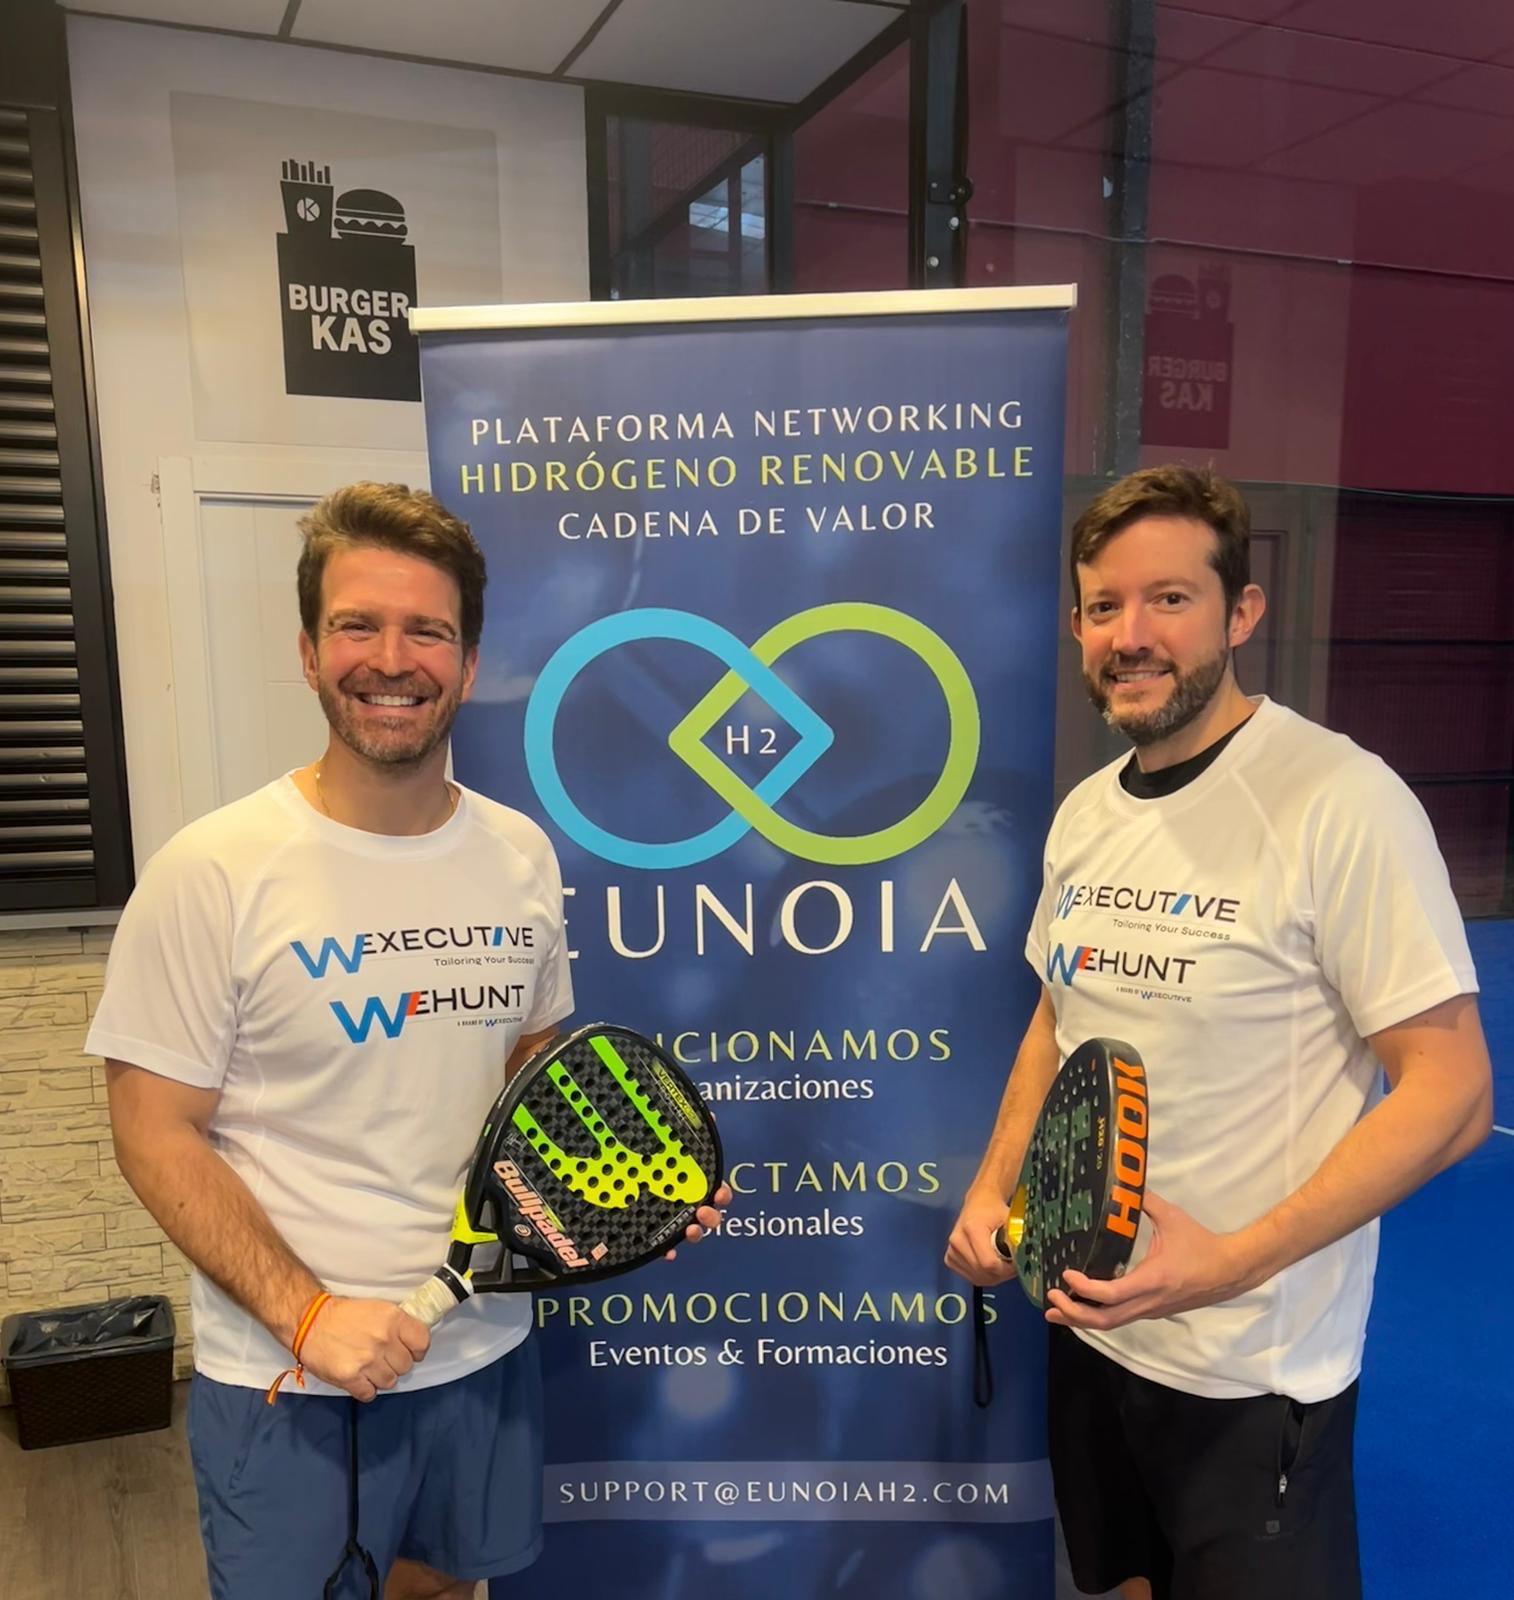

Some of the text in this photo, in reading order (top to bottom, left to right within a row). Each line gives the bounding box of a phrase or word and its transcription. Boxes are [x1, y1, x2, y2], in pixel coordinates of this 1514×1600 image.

[288, 283, 410, 318] BURGER
[311, 315, 392, 354] KAS
[472, 401, 1022, 446] PLATAFORMA NETWORKING
[461, 446, 1034, 494] HIDRÓGENO RENOVABLE
[558, 502, 935, 540] CADENA DE VALOR
[1113, 918, 1231, 941] Tailoring Your Success
[433, 956, 482, 967] Tailoring
[484, 956, 506, 964] Your
[1046, 940, 1197, 986] WEHUNT
[329, 984, 525, 1044] WEHUNT
[656, 1029, 952, 1063] CIONAMOS
[693, 1073, 874, 1101] anizaciones
[1106, 1057, 1148, 1240] HOOK
[729, 1161, 940, 1194] CTAMOS
[493, 1159, 590, 1268] Bullpadel
[538, 1291, 998, 1327] PROMOCIONAMOS
[590, 1338, 948, 1367] Eventos & Formaciones
[559, 1480, 1009, 1506] SUPPORT@EUNOIAH2.COM
